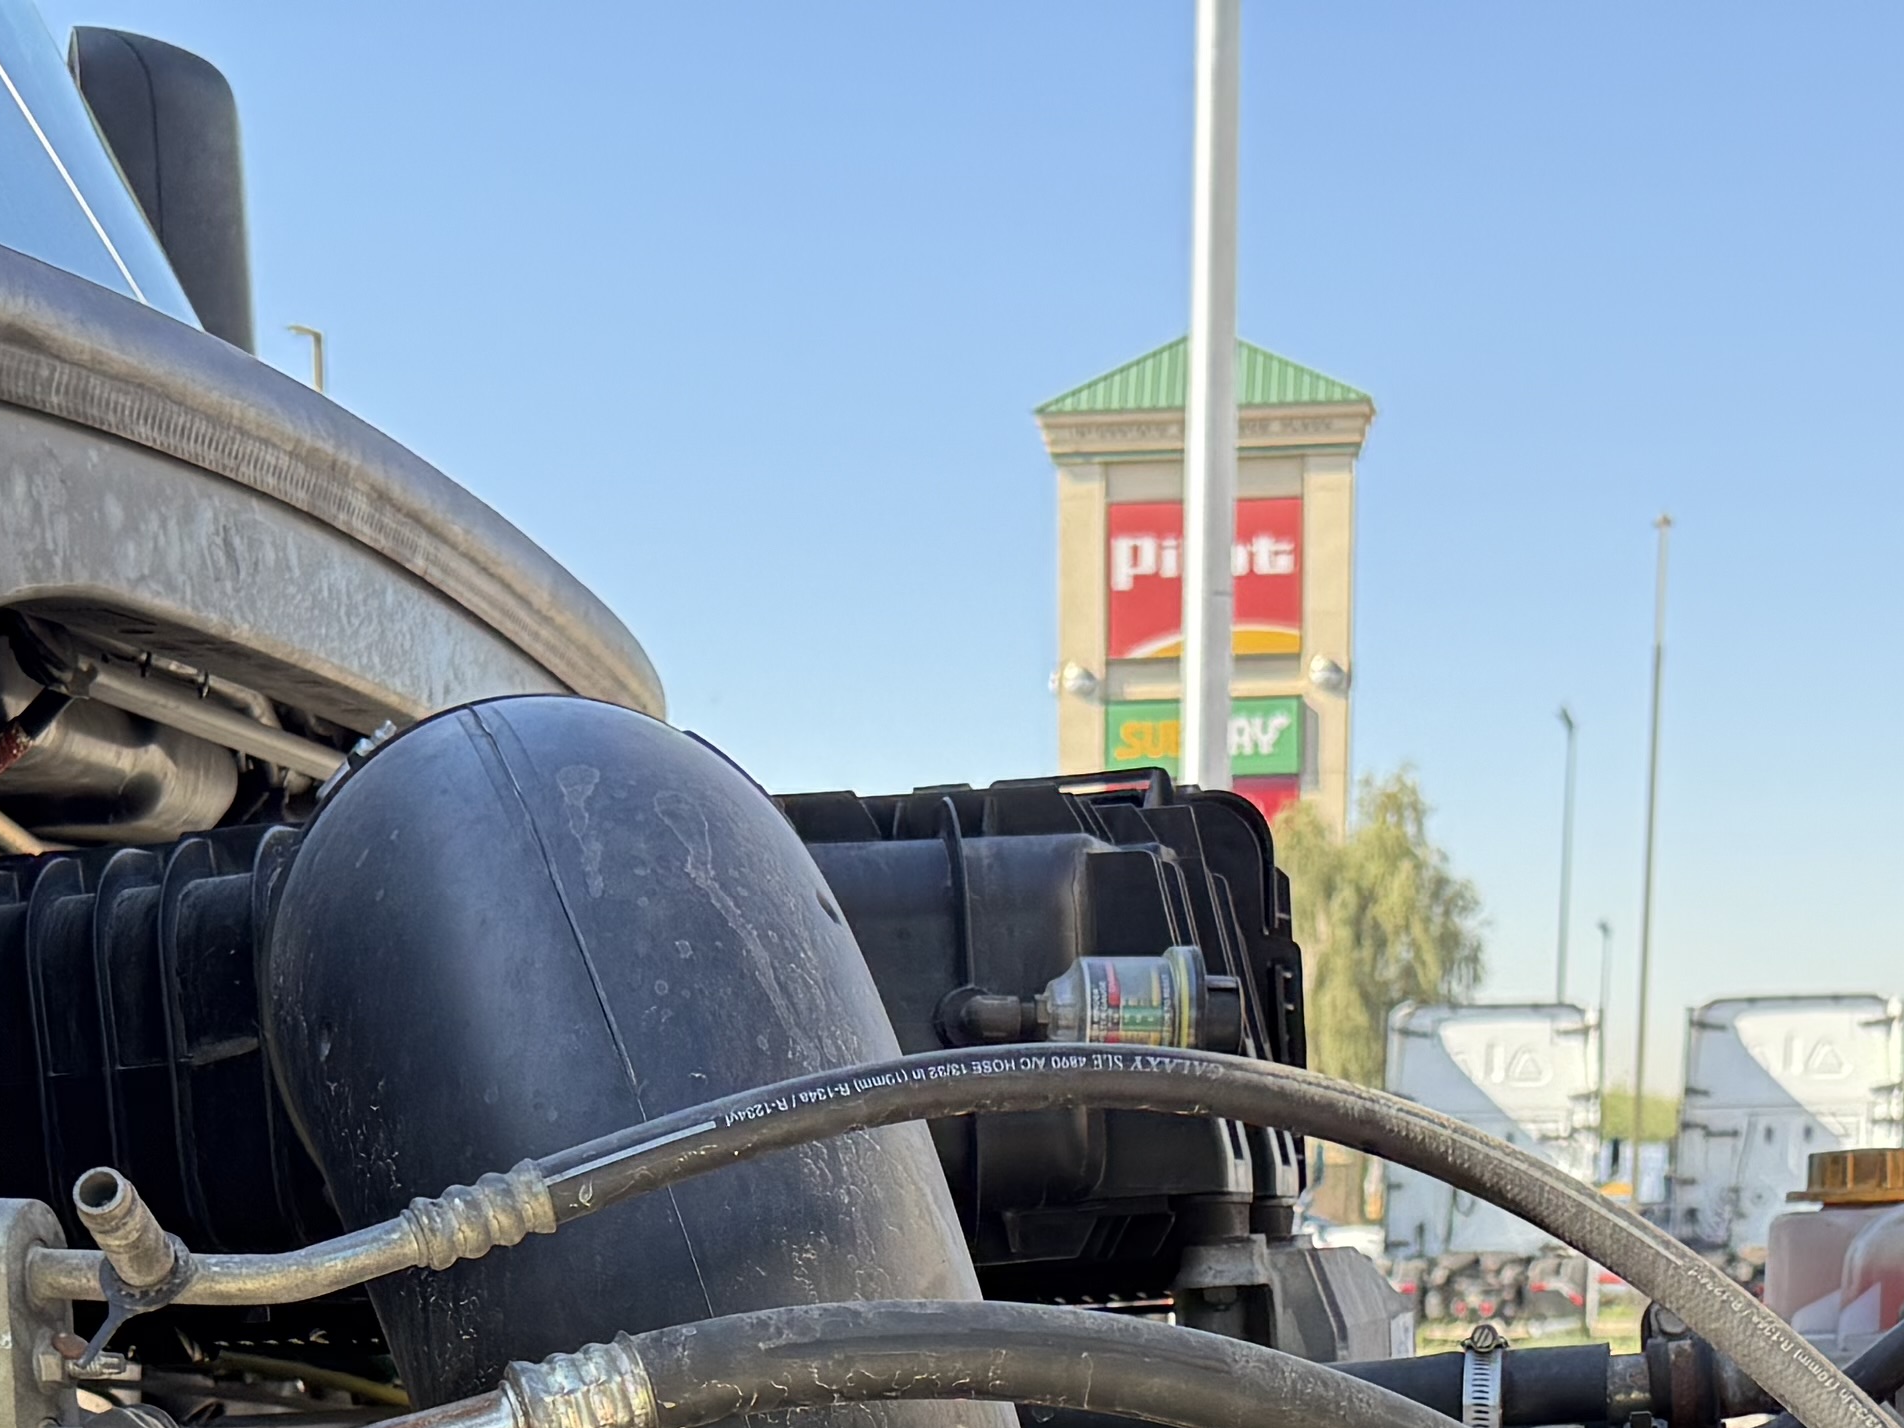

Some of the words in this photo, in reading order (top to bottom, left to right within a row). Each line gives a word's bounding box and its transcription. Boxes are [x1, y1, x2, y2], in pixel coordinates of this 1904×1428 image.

[1110, 533, 1297, 591] Pit
[972, 1059, 1016, 1074] HOSE
[1021, 1056, 1046, 1071] A/C
[1052, 1056, 1086, 1069] 4890
[1093, 1055, 1123, 1071] SLE
[1131, 1056, 1224, 1079] GALAXY
[930, 1063, 968, 1079] 13/32
[854, 1071, 909, 1092] (10mm)
[800, 1083, 851, 1103] R-134a
